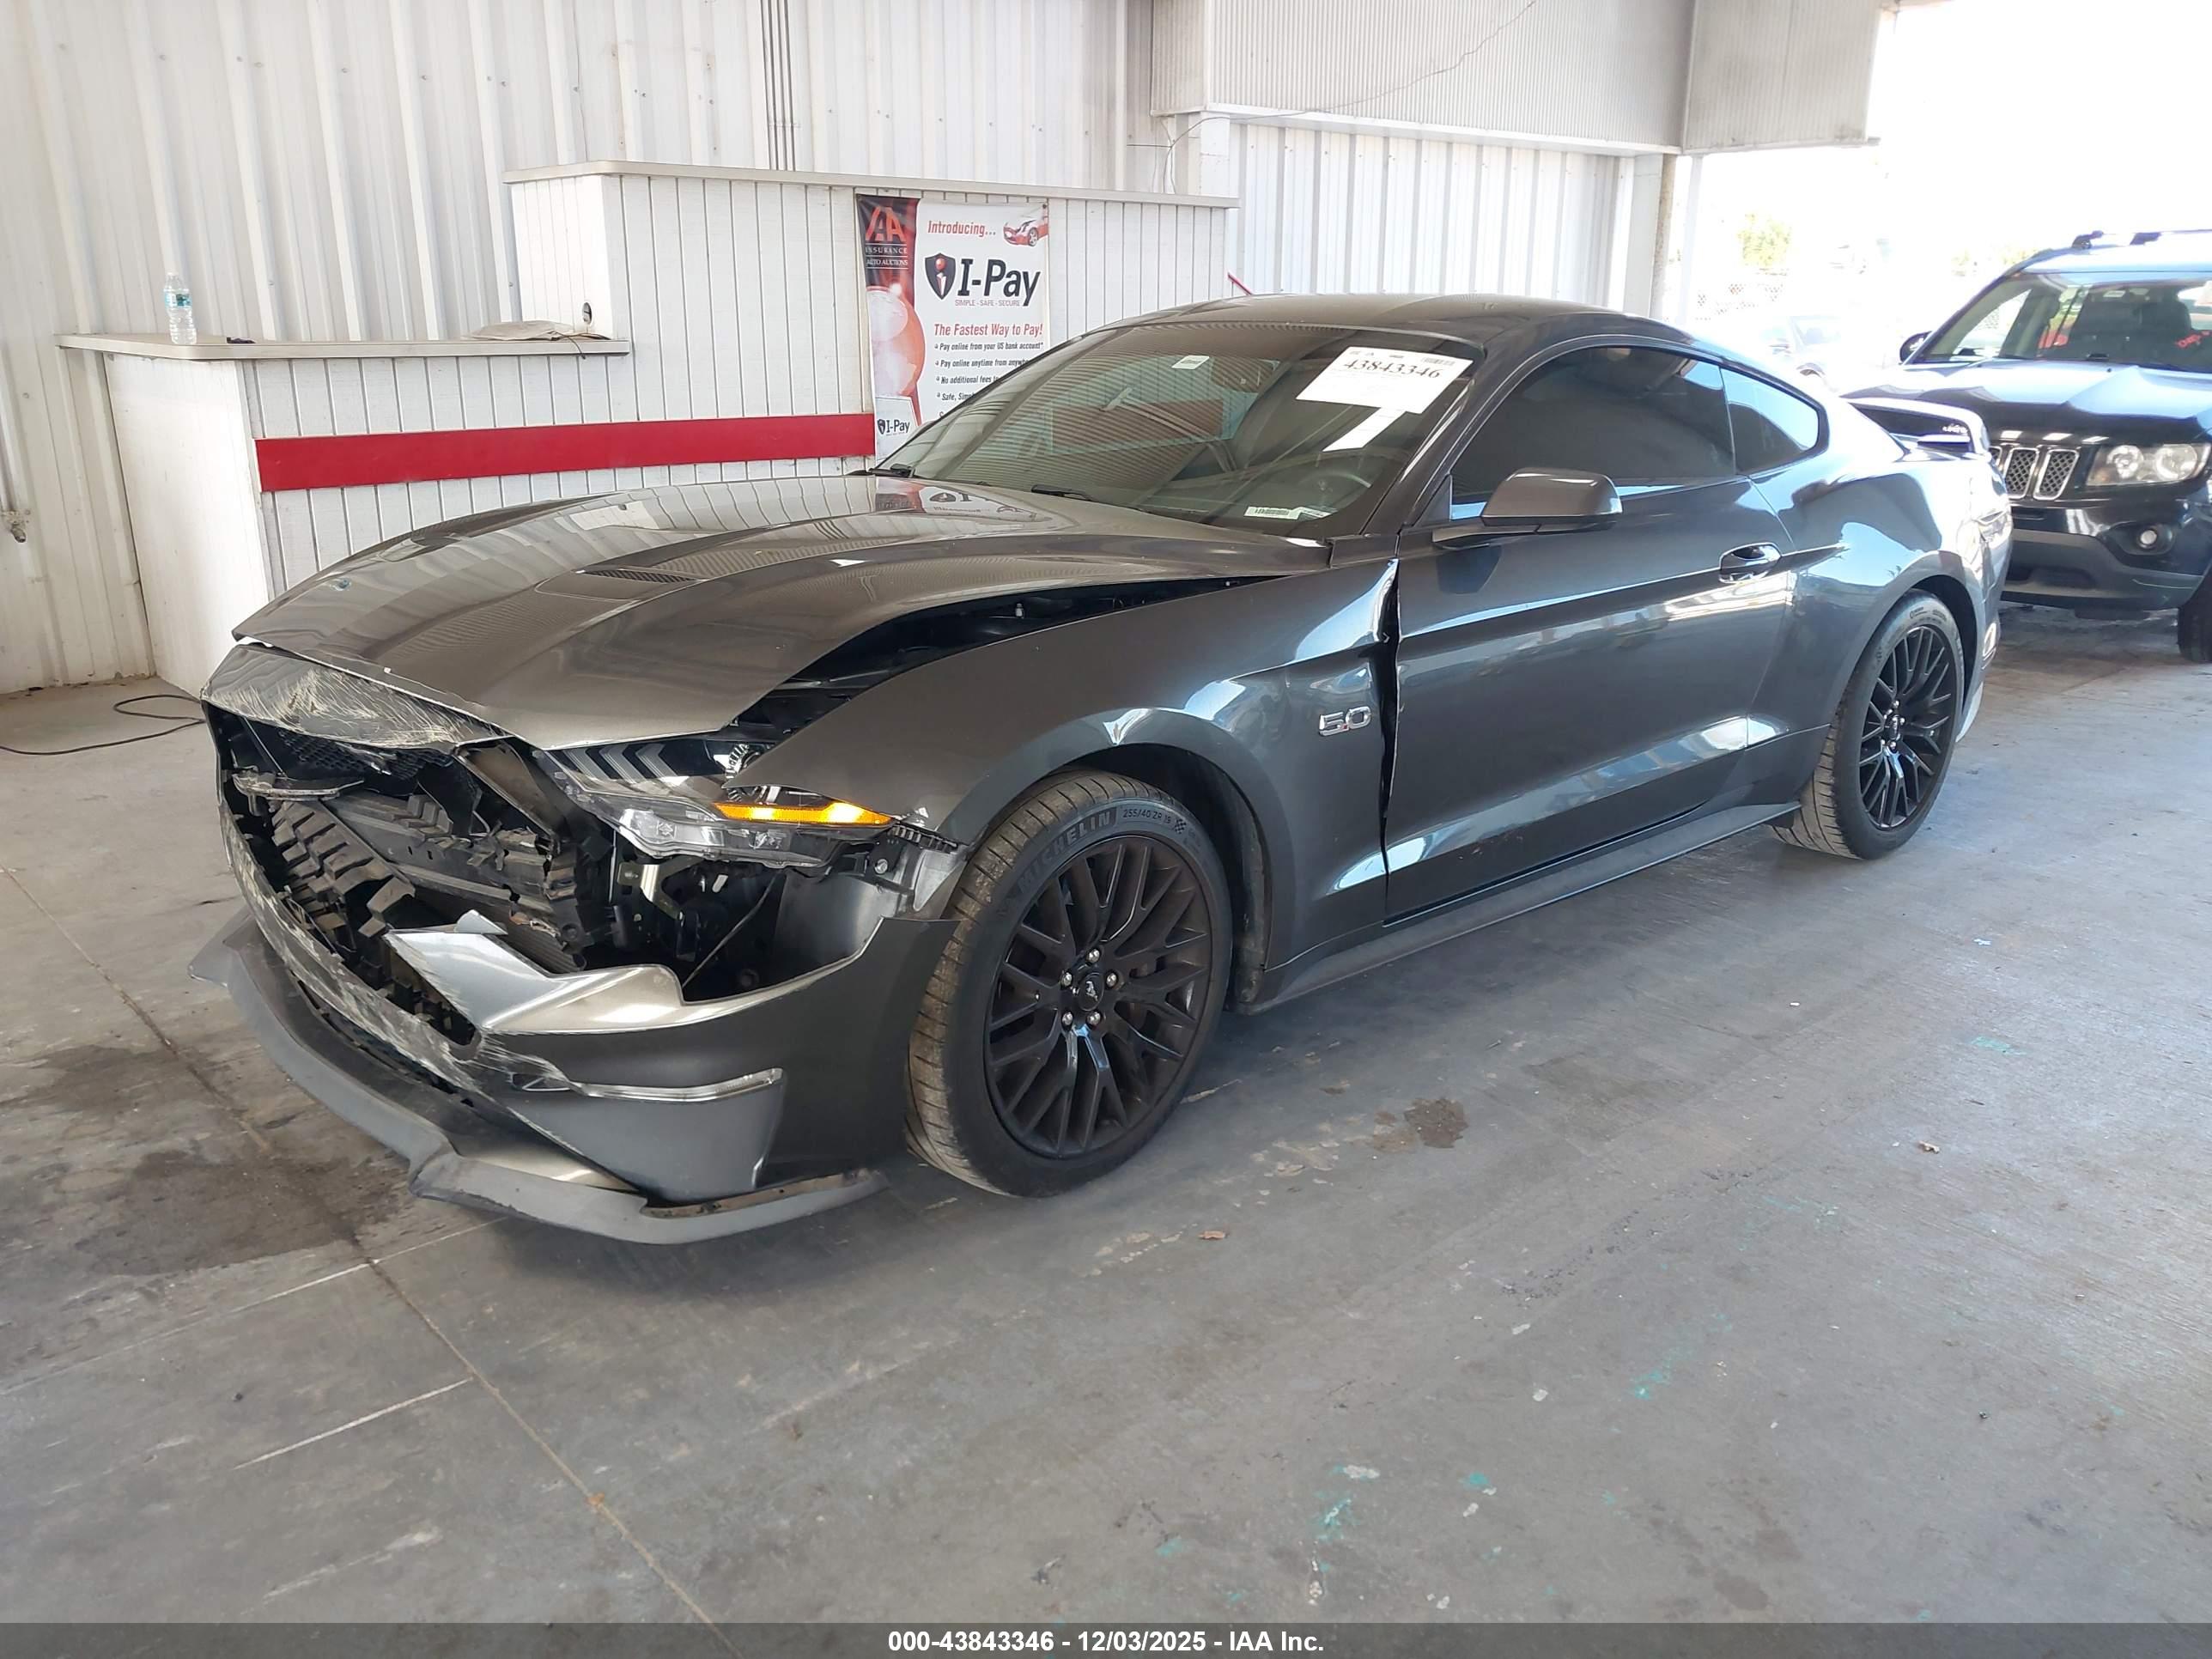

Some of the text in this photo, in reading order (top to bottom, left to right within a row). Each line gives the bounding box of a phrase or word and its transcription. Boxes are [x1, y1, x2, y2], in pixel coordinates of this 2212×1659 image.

[928, 220, 996, 237] Introducing...
[957, 258, 1041, 307] I-Pay
[934, 324, 1043, 337] The Fastest Way to Pay!
[939, 343, 950, 352] Pay
[940, 360, 951, 368] Pay
[952, 359, 969, 368] online
[971, 359, 994, 368] anytime
[1343, 359, 1443, 379] 43843346
[941, 392, 957, 402] Safe,
[886, 419, 910, 433] I-Pay
[1017, 811, 1110, 894] MICHELIN
[1122, 808, 1152, 819] 255/40
